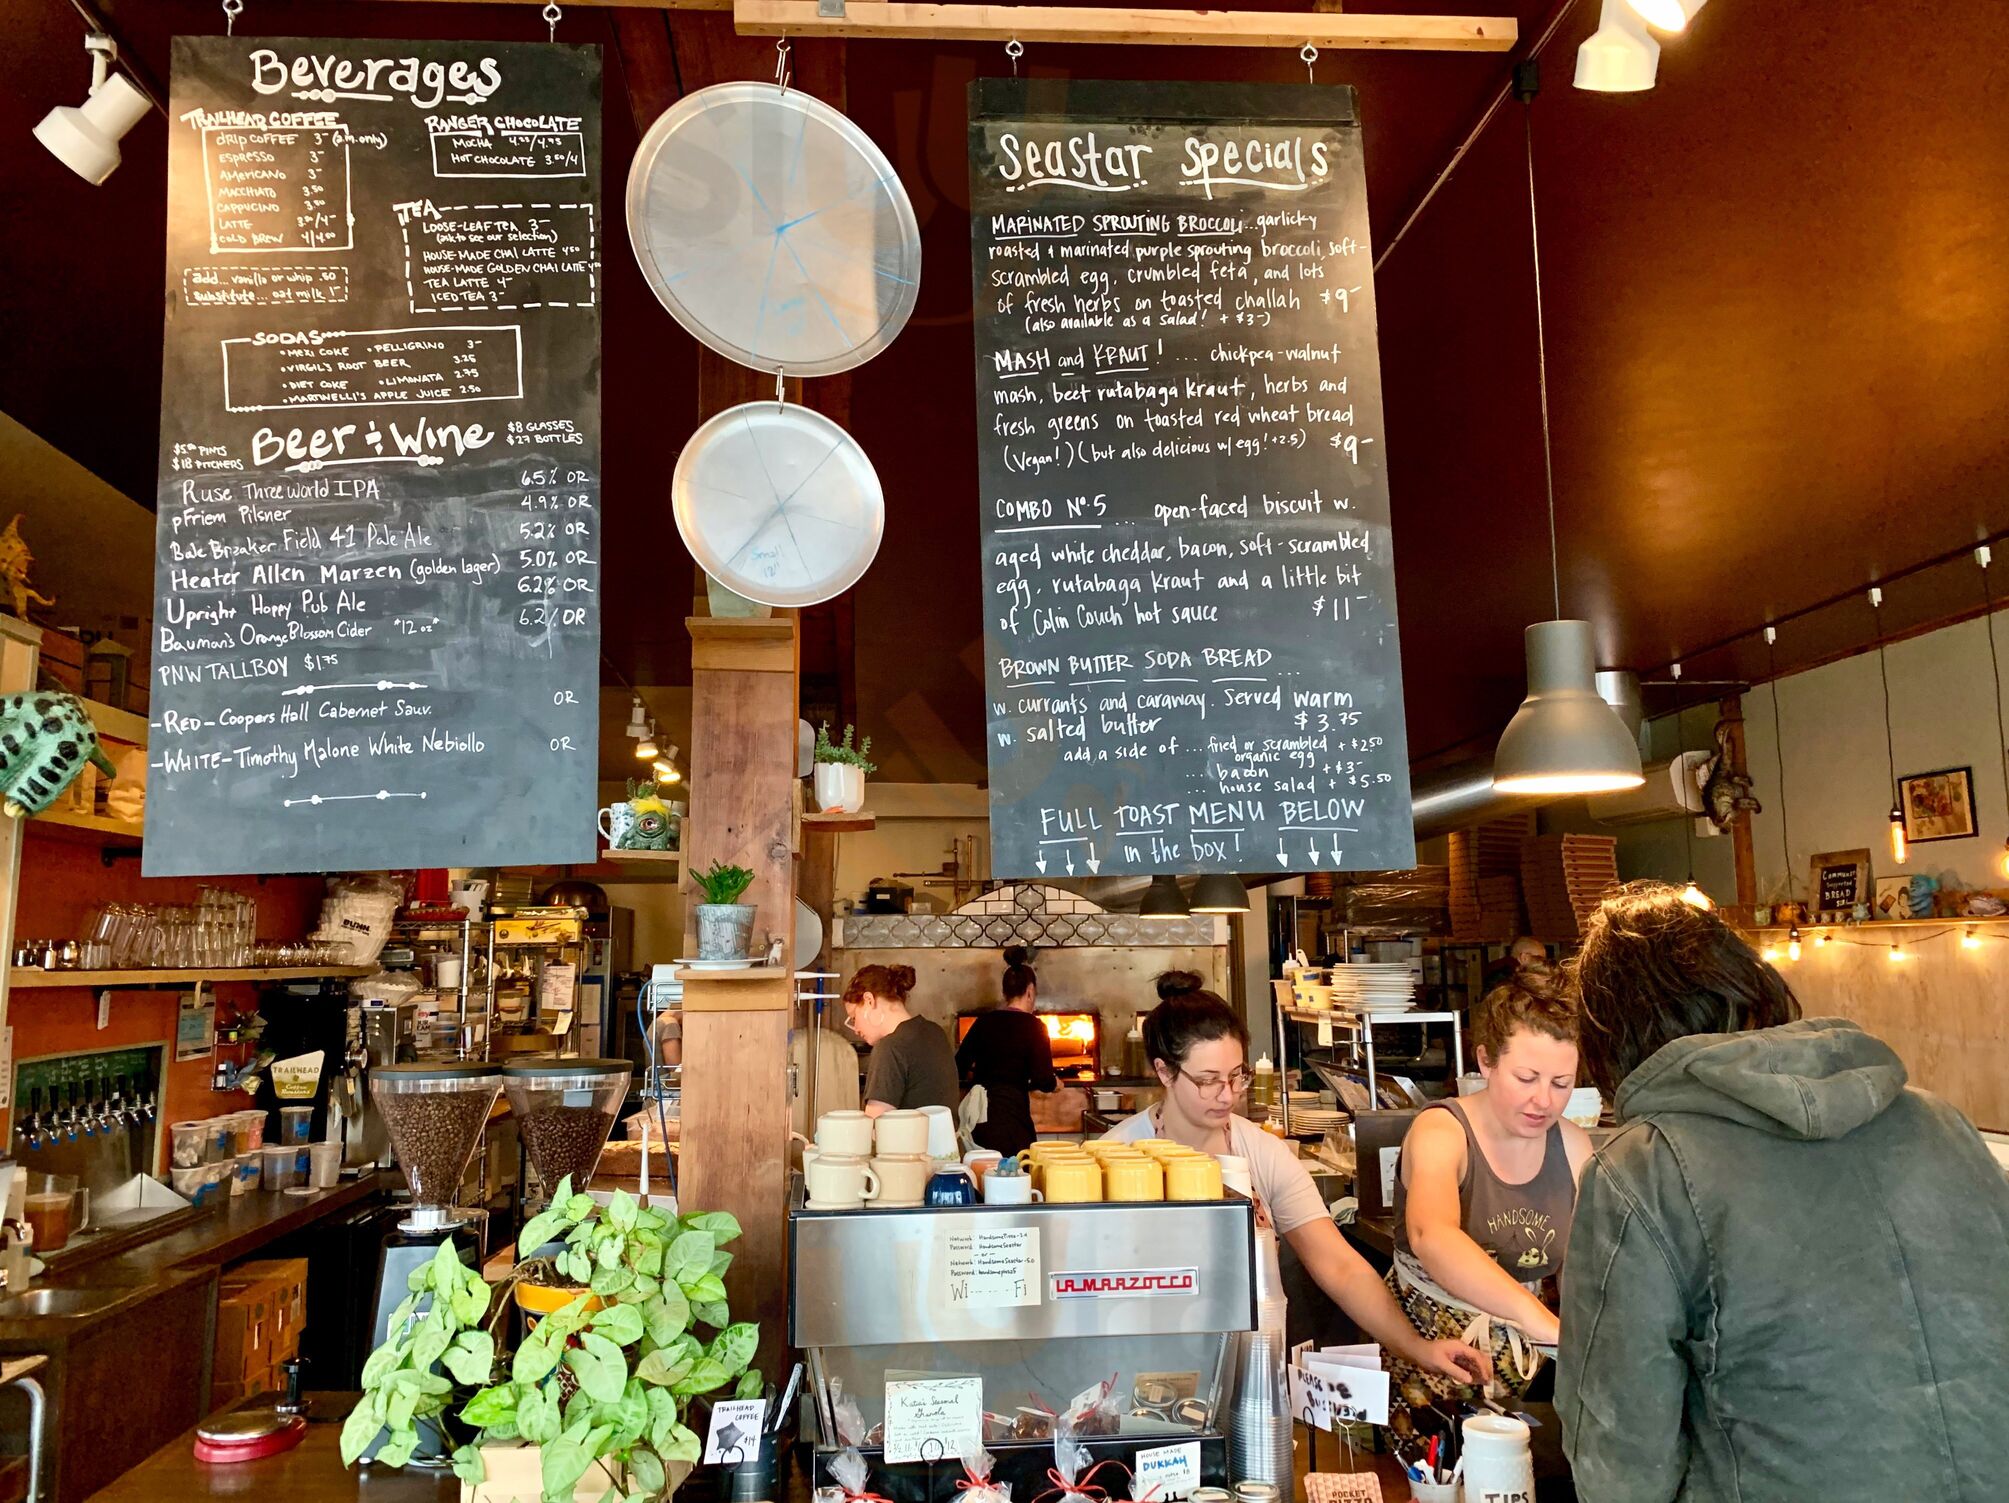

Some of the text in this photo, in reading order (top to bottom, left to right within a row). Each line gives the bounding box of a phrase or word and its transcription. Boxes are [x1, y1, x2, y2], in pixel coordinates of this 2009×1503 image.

[249, 49, 502, 109] Beverages
[268, 111, 340, 126] COFFEE
[424, 115, 583, 136] RANGER CHOCOLATE
[474, 155, 536, 167] CHOCOLATE
[1180, 136, 1329, 200] Specials
[393, 199, 442, 226] TEA
[508, 229, 558, 244] selection)
[988, 238, 1252, 265] roasted marinated purple sprouting
[230, 271, 313, 285] vanilla or whip
[487, 262, 531, 274] GOLDEN
[991, 262, 1325, 288] scrambled crumbled and lots
[271, 287, 326, 300] oat milk
[423, 276, 489, 289] TEA LATTE
[431, 290, 485, 304] ICED TEA
[996, 287, 1300, 315] of fresh herbs on toasted challah
[1060, 311, 1137, 329] available as
[251, 329, 324, 347] SODAS
[374, 358, 411, 370] BEER
[993, 343, 1149, 372] MASH and KRAUT
[374, 387, 452, 401] APPLE JUICE
[1052, 373, 1348, 407] beet rutabaga herbs and
[526, 419, 575, 432] GLASSES
[993, 402, 1354, 440] fresh greens on toasted red wheat bread
[251, 416, 495, 466] Beer Wine
[533, 432, 584, 446] BOTTLES
[1121, 436, 1211, 460] also delicious
[333, 470, 590, 501] IPA OR
[238, 495, 593, 525] Pilsner OR
[1262, 488, 1323, 516] biscuit
[282, 521, 590, 551] Field 41 Pale Ale OR
[171, 549, 597, 592] Heater Allen Marzen lager) OR
[995, 540, 1095, 580] aged white
[1051, 563, 1362, 607] rutabaga kraut and a little bit
[166, 576, 595, 630] Upright Hoppy Pub Ale OR
[239, 609, 586, 648] Orange Blossom Cider OR
[999, 600, 1219, 636] of hot sauce
[158, 655, 288, 687] PNW TALLBOY
[998, 649, 1192, 680] BROWN SODA
[280, 690, 580, 724] Hall OR
[1099, 690, 1353, 713] and warm
[1026, 711, 1163, 742] salted butter
[368, 730, 577, 756] White OR
[1063, 734, 1328, 763] add side scrambled
[1288, 751, 1315, 769] egg
[1219, 775, 1316, 795] house salad
[1189, 797, 1366, 826] MENU BELOW
[1150, 836, 1181, 864] the
[1824, 888, 1851, 901] BREAD
[273, 1066, 320, 1074] TRAILHEAD
[1486, 1207, 1552, 1235] HANDSOME
[1297, 1368, 1324, 1392] PLEASE
[717, 1404, 755, 1414] TRAILHEAD
[1140, 1451, 1160, 1460] HOUSE
[1331, 1489, 1367, 1499] POCKET
